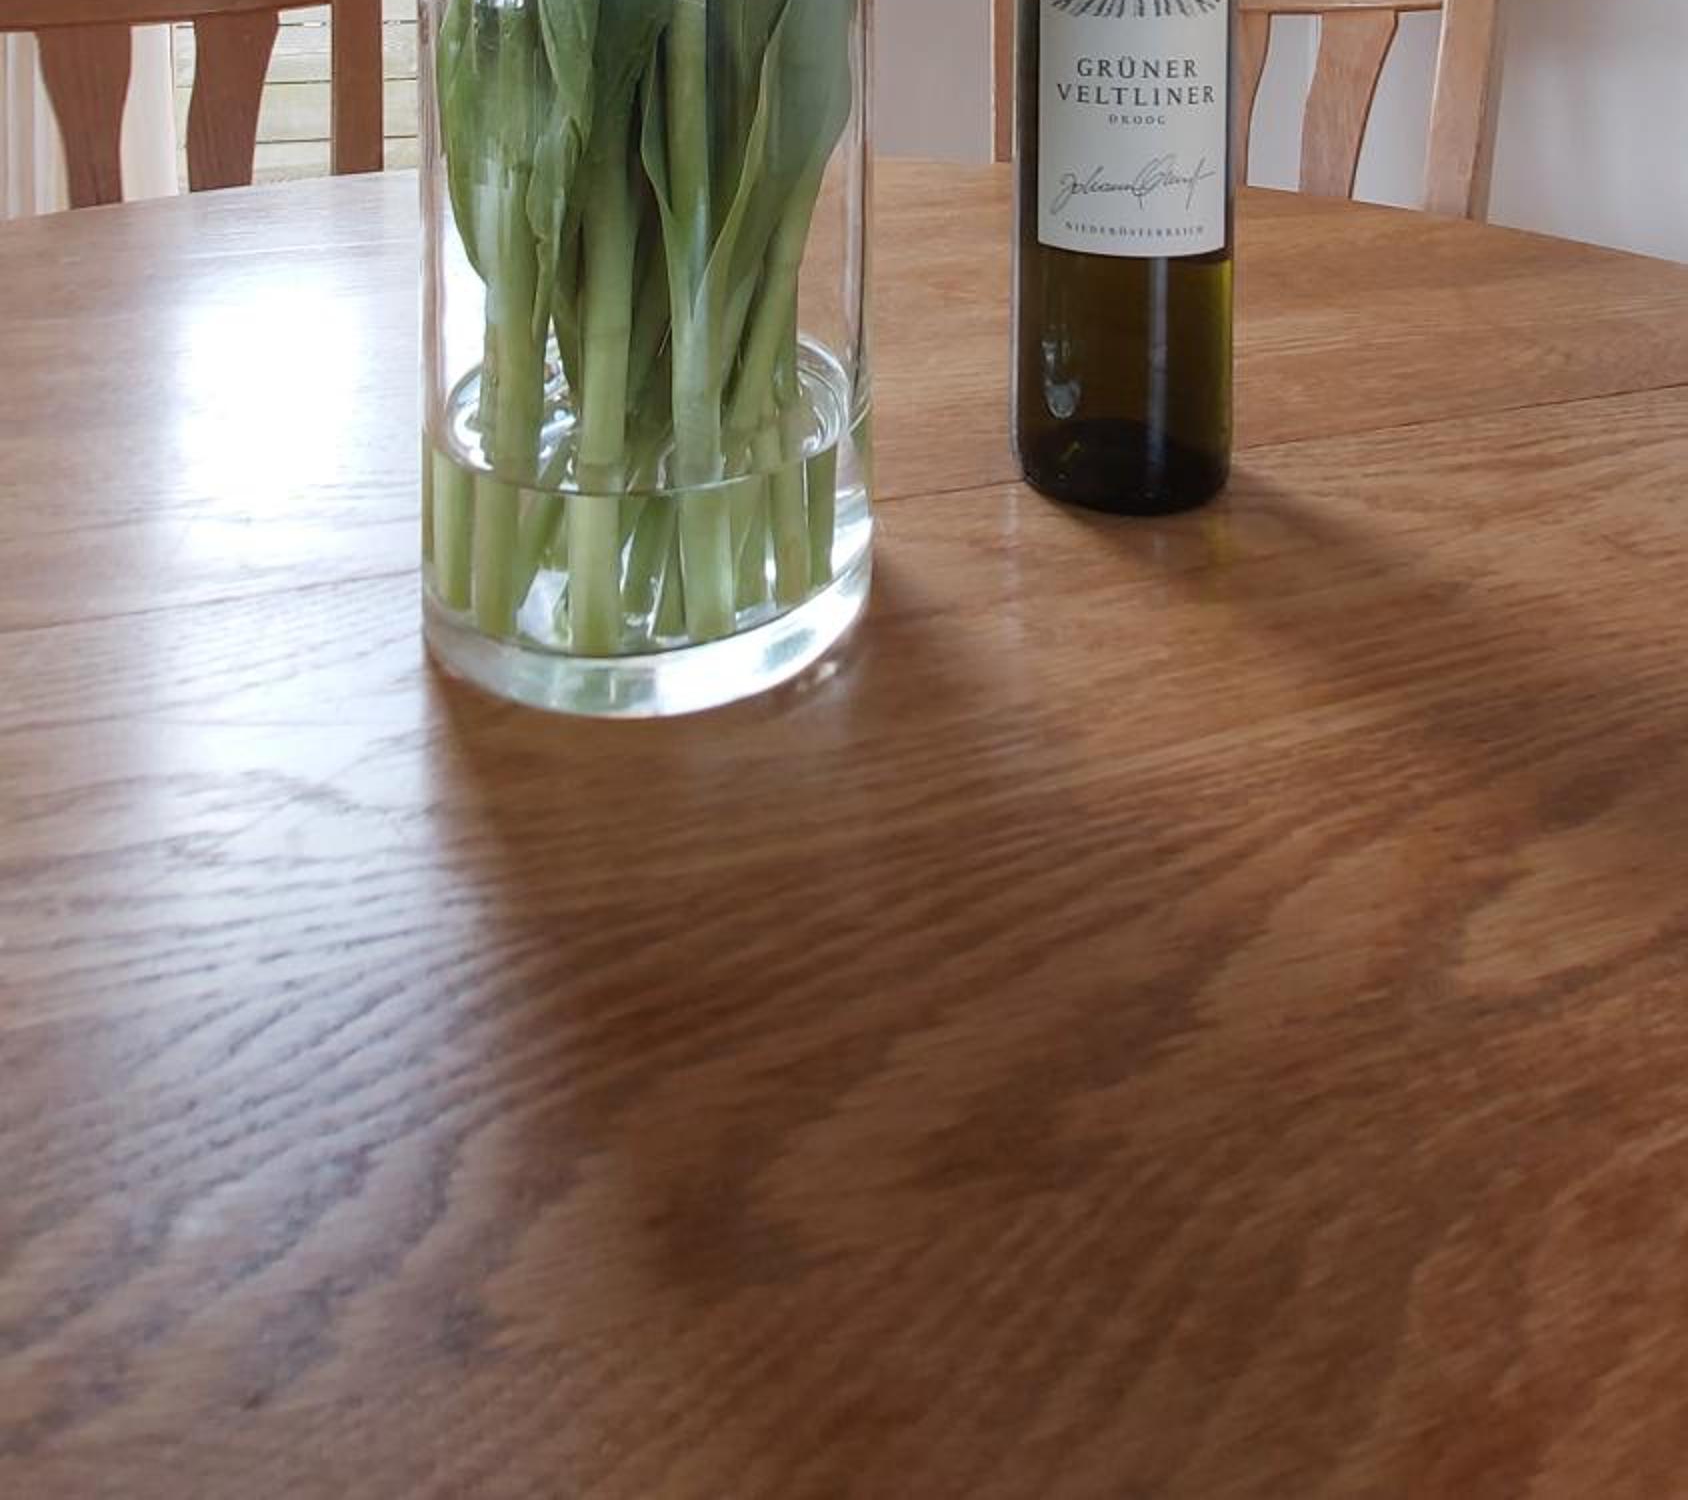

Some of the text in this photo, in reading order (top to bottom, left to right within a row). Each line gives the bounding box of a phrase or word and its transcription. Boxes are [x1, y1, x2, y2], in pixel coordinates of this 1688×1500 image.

[1076, 55, 1198, 79] GRÜNER
[1057, 83, 1215, 107] VELTLINER
[1108, 114, 1166, 126] DROOG
